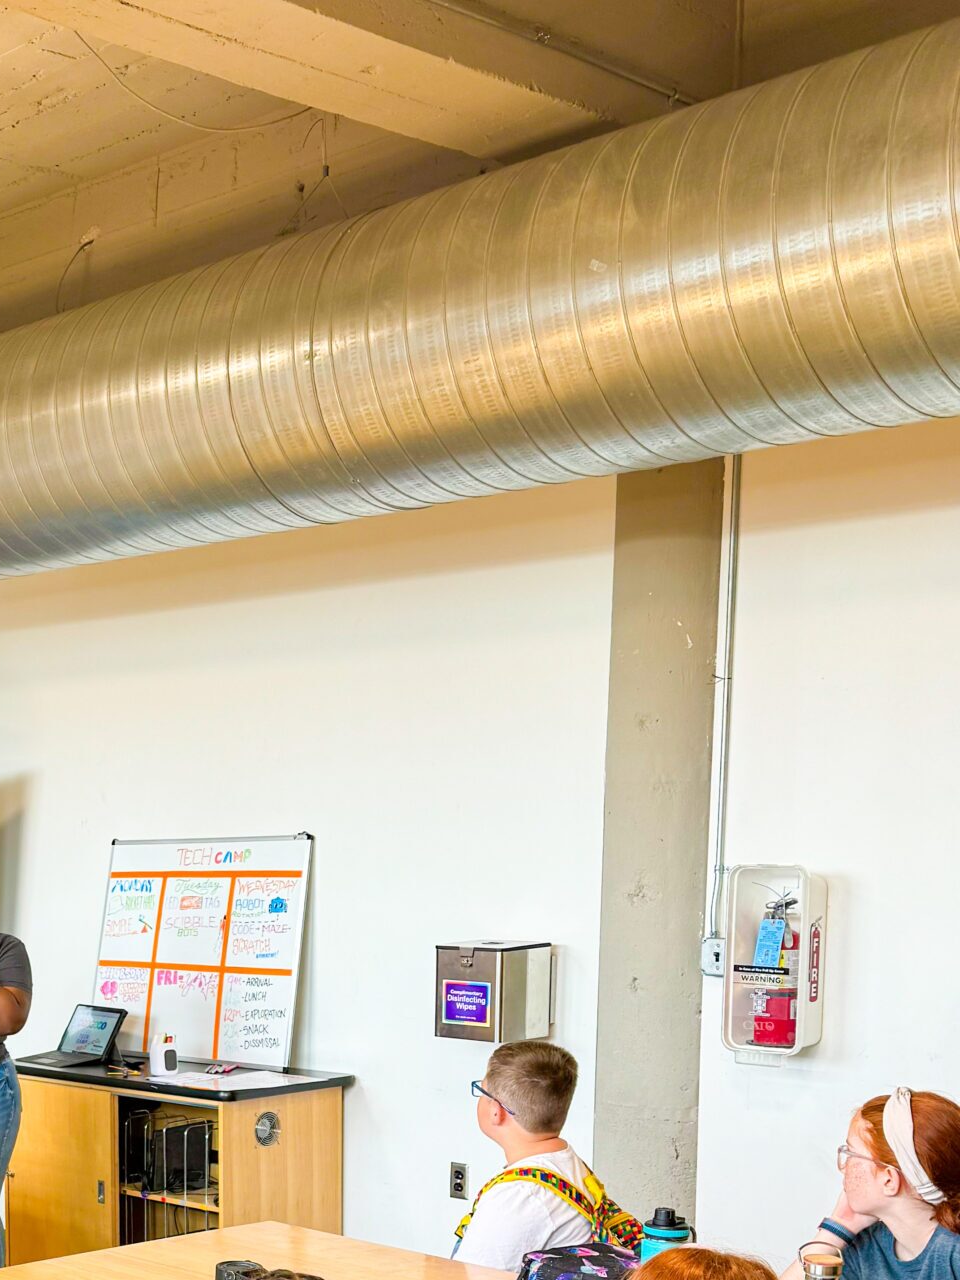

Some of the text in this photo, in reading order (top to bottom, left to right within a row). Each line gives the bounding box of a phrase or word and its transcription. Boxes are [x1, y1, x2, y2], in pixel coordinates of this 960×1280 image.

[177, 848, 252, 866] TECH CAMP
[204, 896, 220, 909] TAG
[811, 937, 819, 997] FIRE
[447, 994, 486, 1005] Disinfecting
[456, 1002, 477, 1011] Wipes
